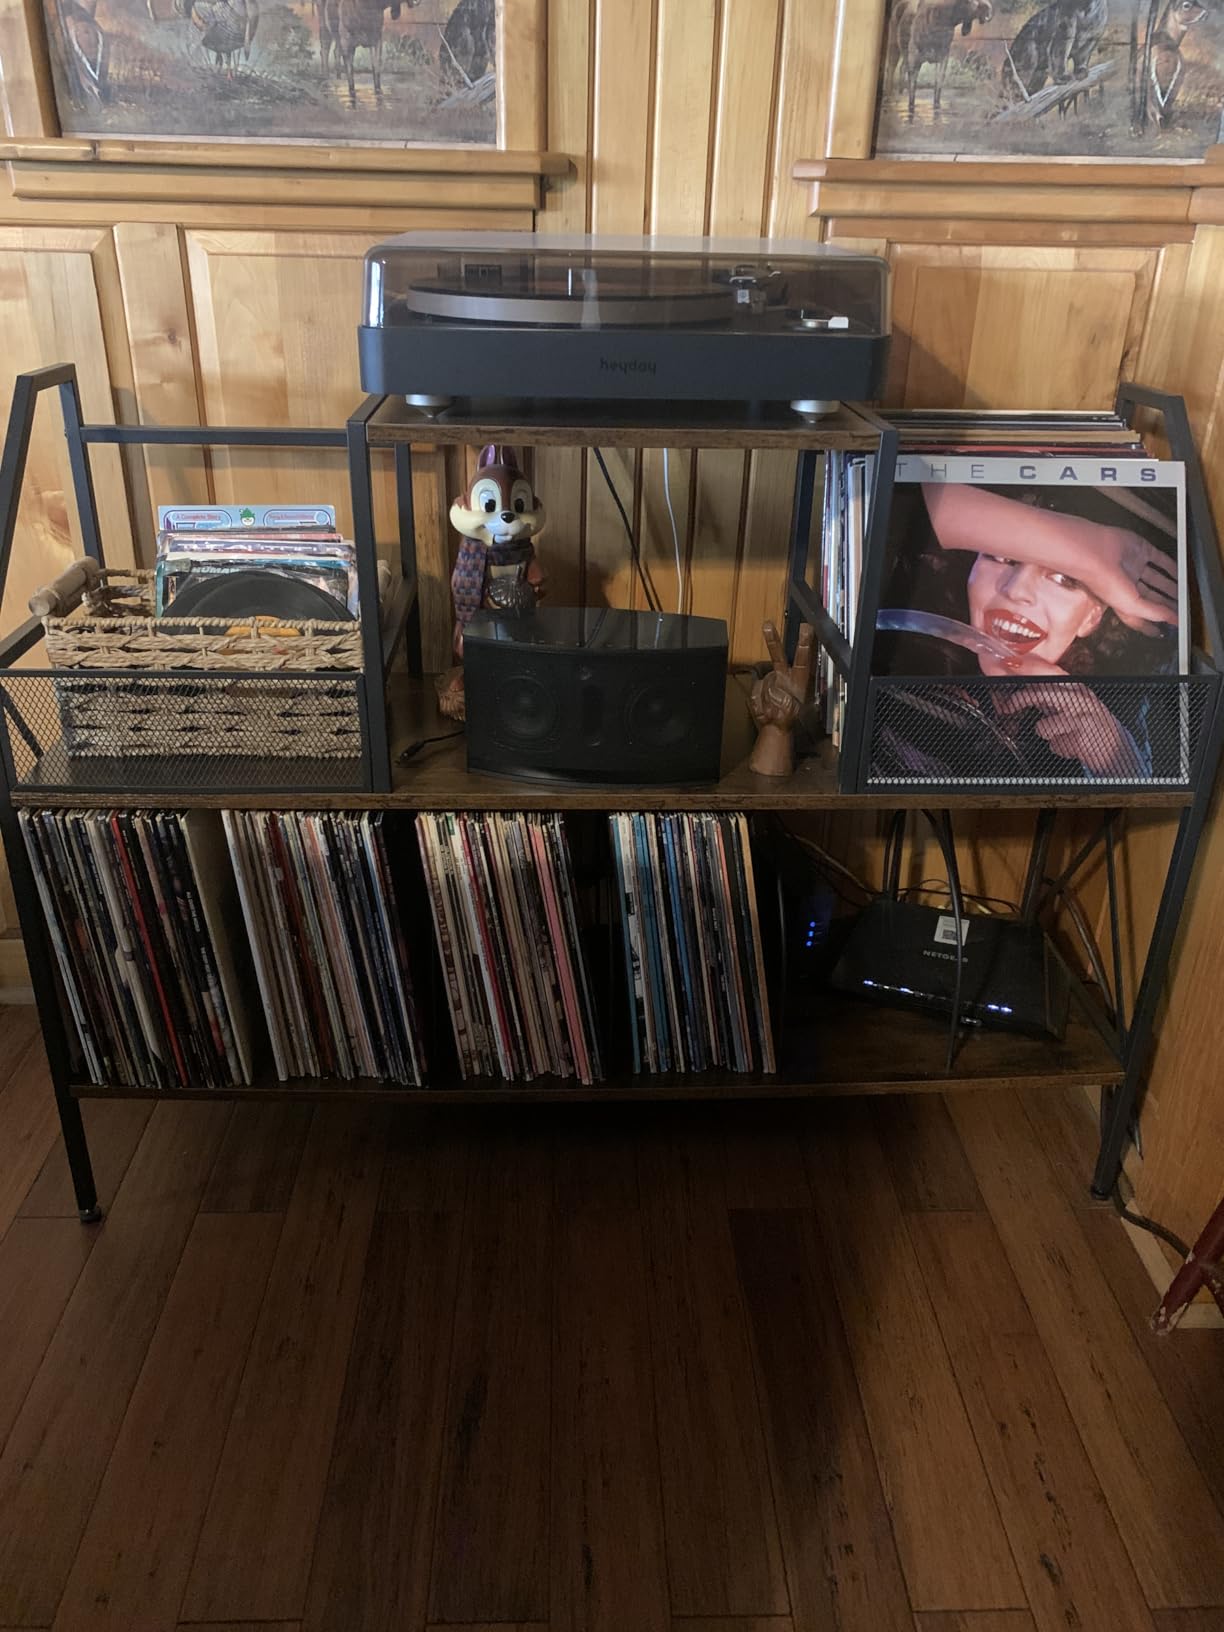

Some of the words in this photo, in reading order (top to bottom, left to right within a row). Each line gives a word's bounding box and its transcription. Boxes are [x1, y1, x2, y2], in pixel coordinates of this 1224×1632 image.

[600, 356, 656, 376] heyday
[895, 462, 985, 479] THE
[1019, 465, 1157, 482] CARS
[922, 950, 969, 963] NETGER
